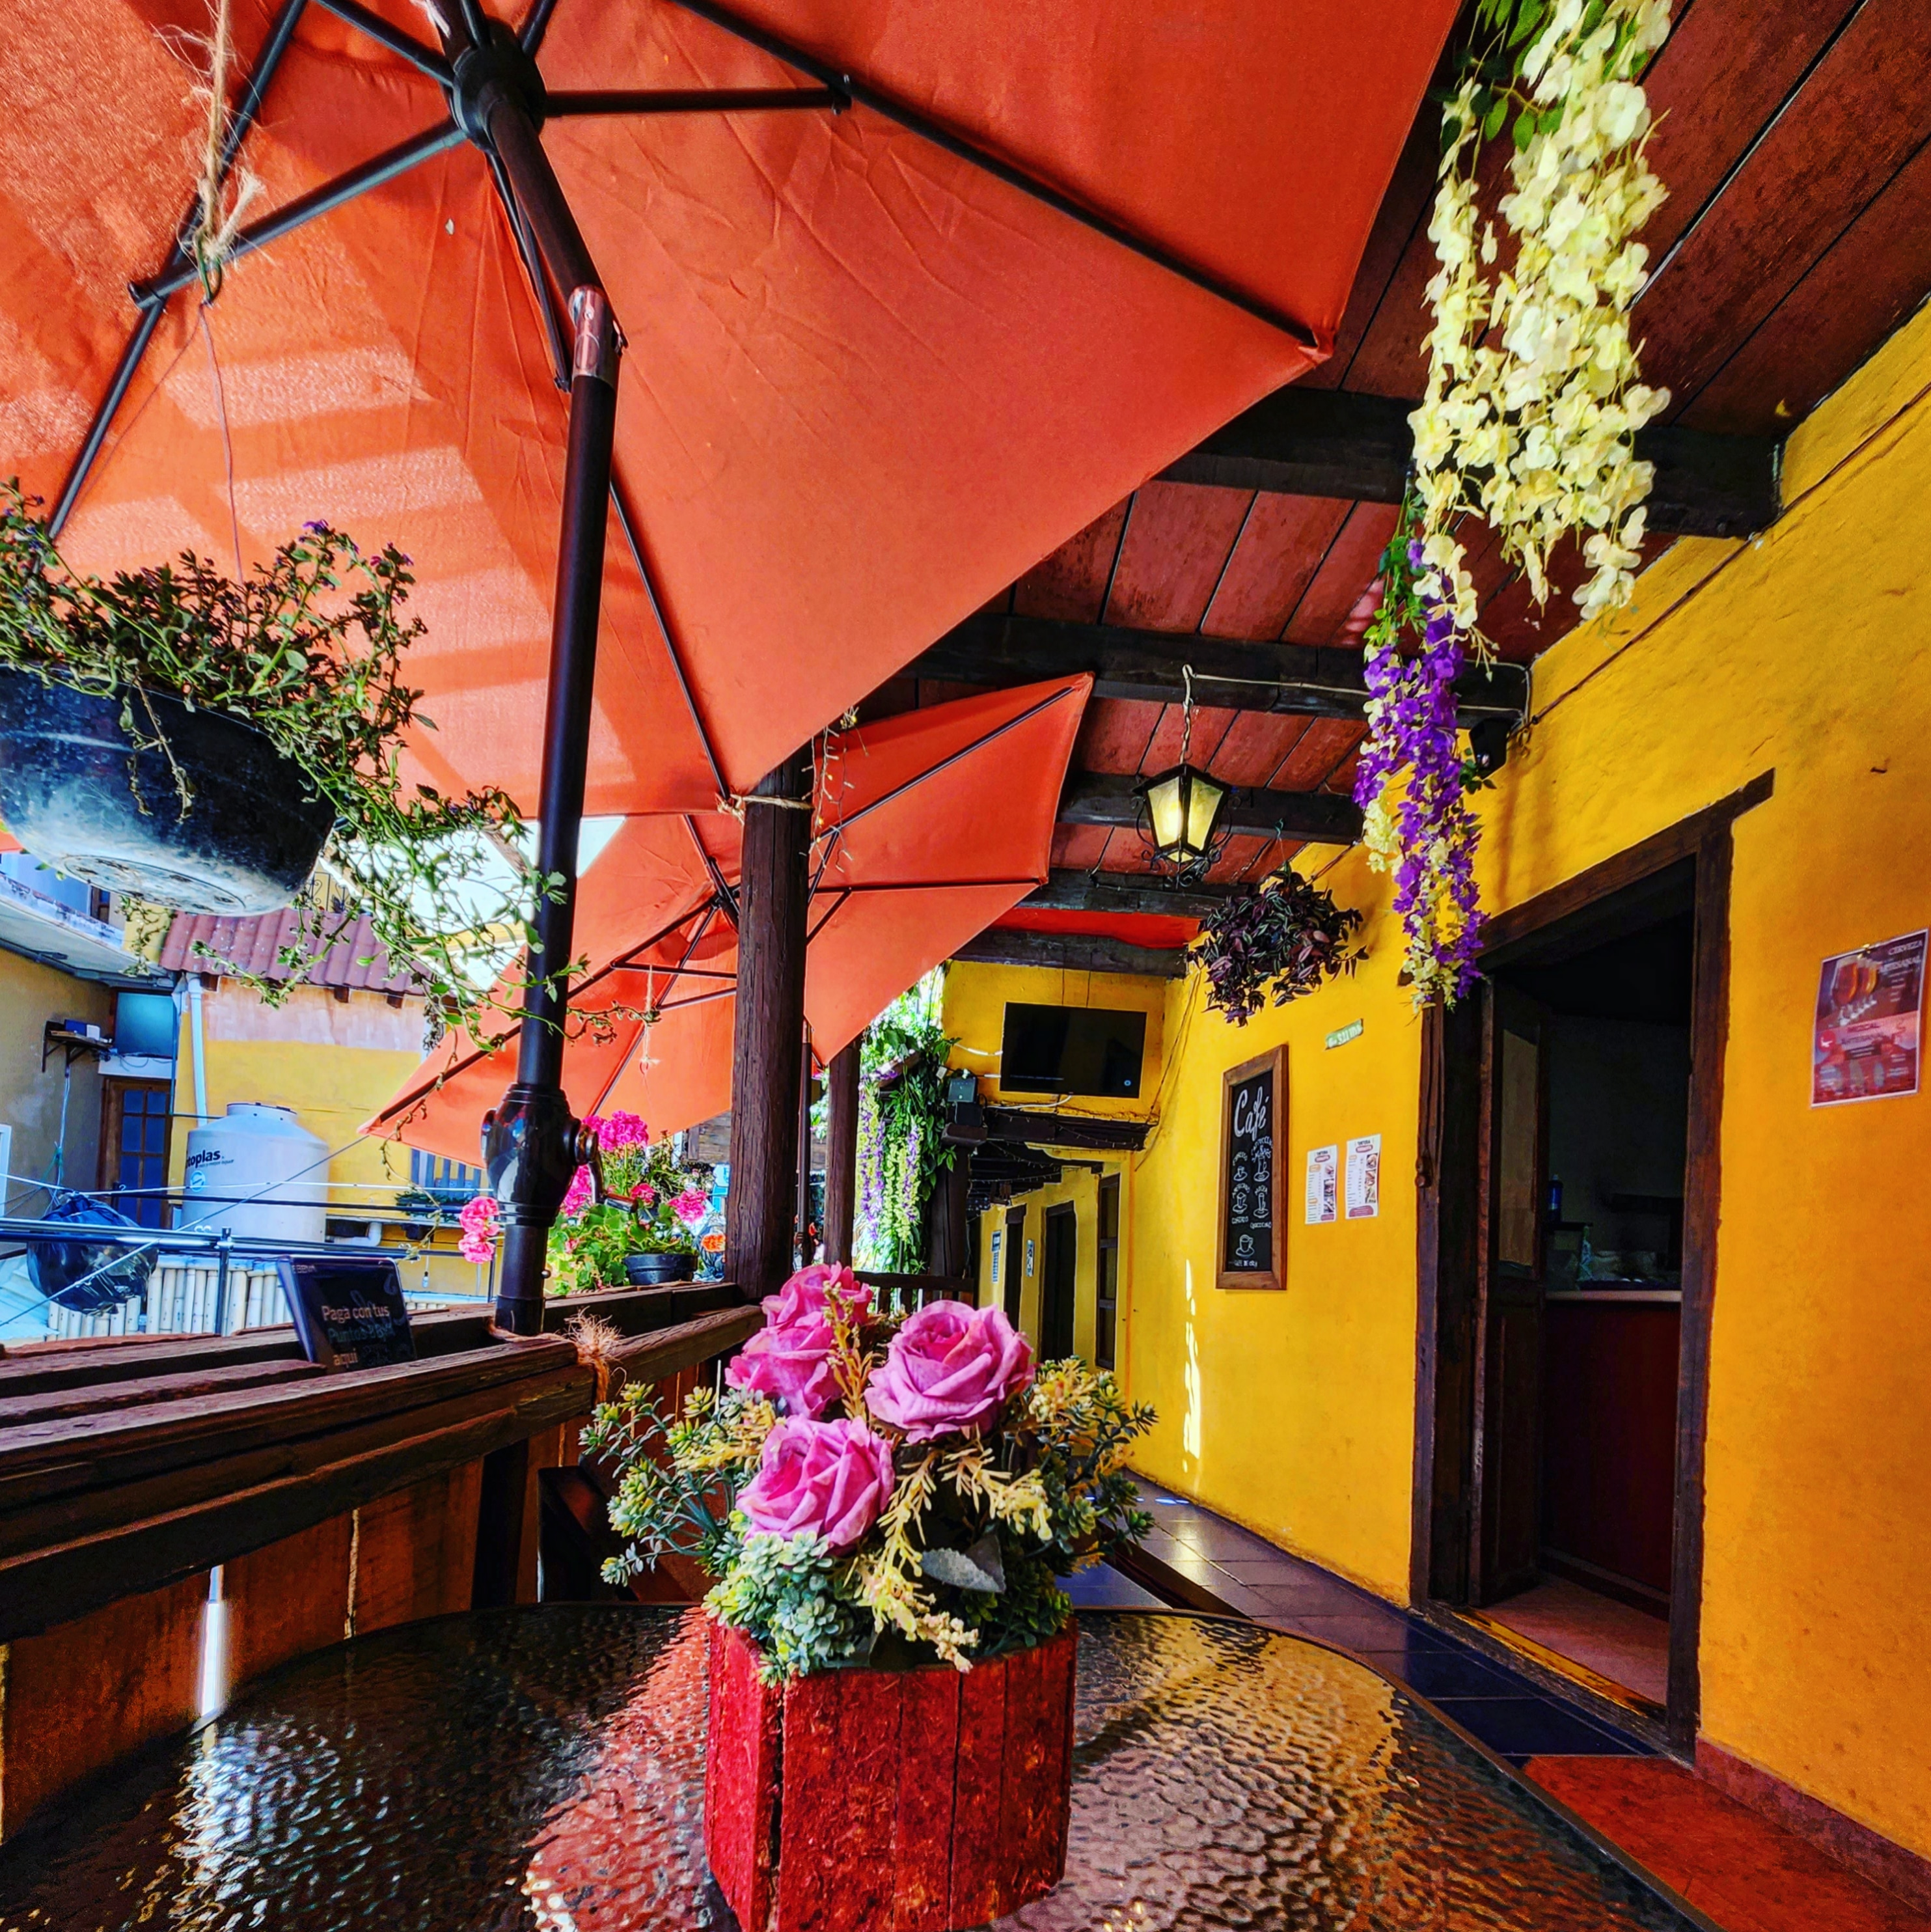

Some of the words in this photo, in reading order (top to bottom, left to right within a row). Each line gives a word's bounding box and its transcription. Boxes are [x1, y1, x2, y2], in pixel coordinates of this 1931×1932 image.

[1888, 941, 1923, 955] CERVEZA
[1234, 1086, 1269, 1142] Café
[321, 1306, 351, 1323] Paga
[352, 1307, 372, 1319] con
[372, 1304, 390, 1318] tus
[327, 1328, 366, 1344] Puntos
